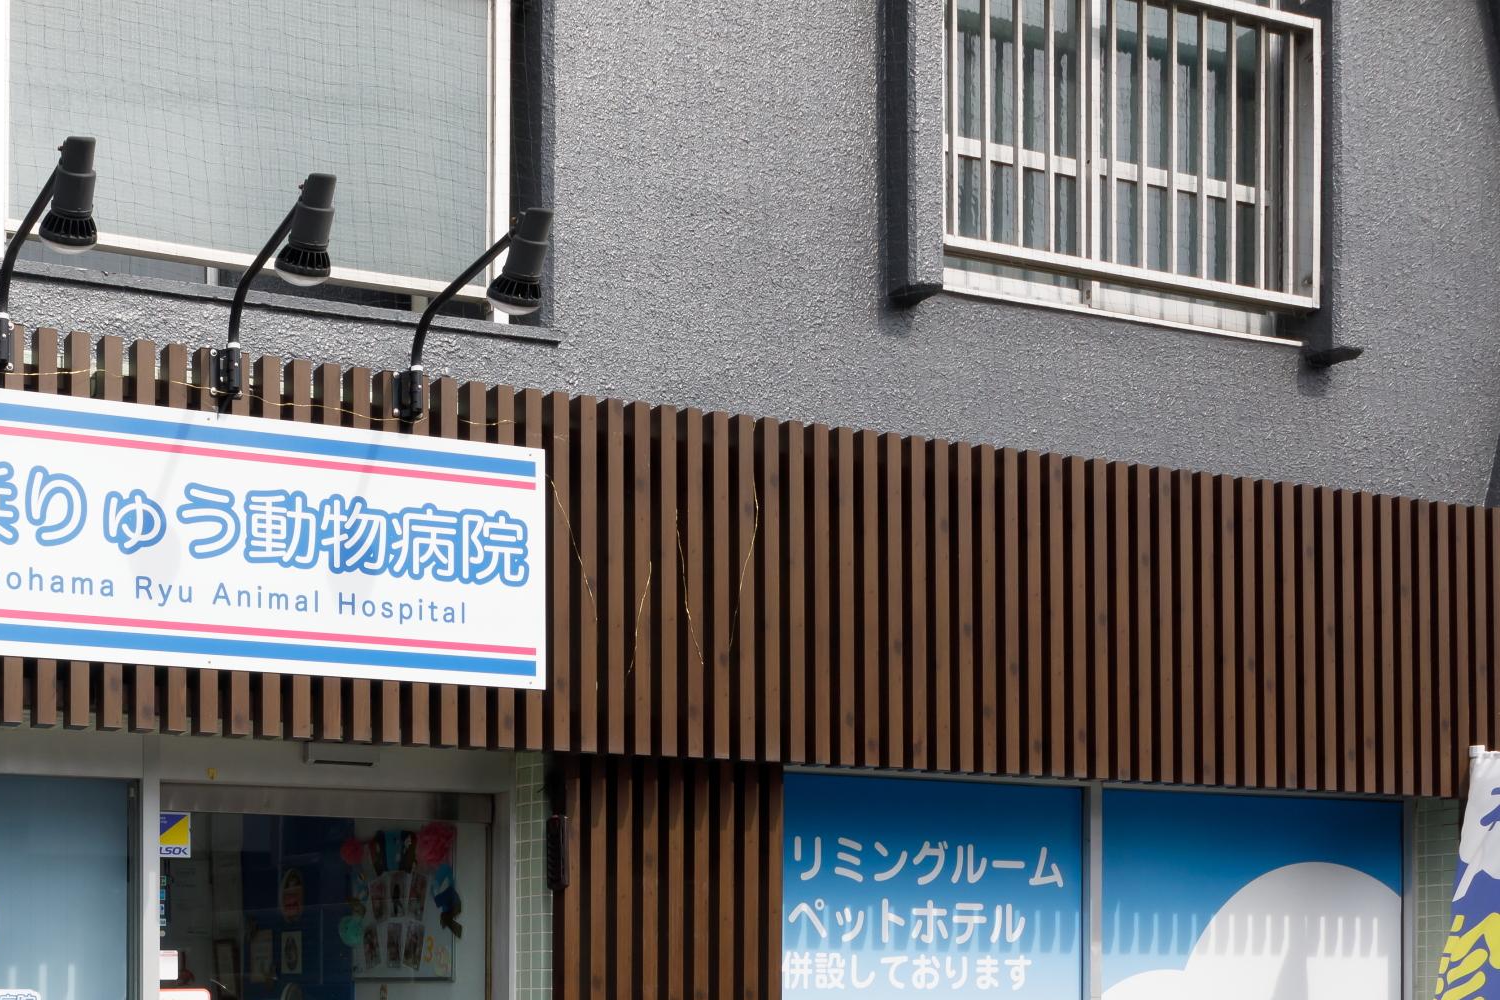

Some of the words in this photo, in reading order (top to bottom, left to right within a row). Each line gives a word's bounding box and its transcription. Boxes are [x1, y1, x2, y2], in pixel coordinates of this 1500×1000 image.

[135, 576, 193, 608] Ryu
[212, 582, 319, 614] Animal
[337, 592, 467, 625] Hospital
[160, 846, 188, 856] LSOK
[794, 836, 1064, 888] リミングルーム
[788, 898, 1026, 944] ペットホテル
[782, 951, 1032, 990] 併設しております
